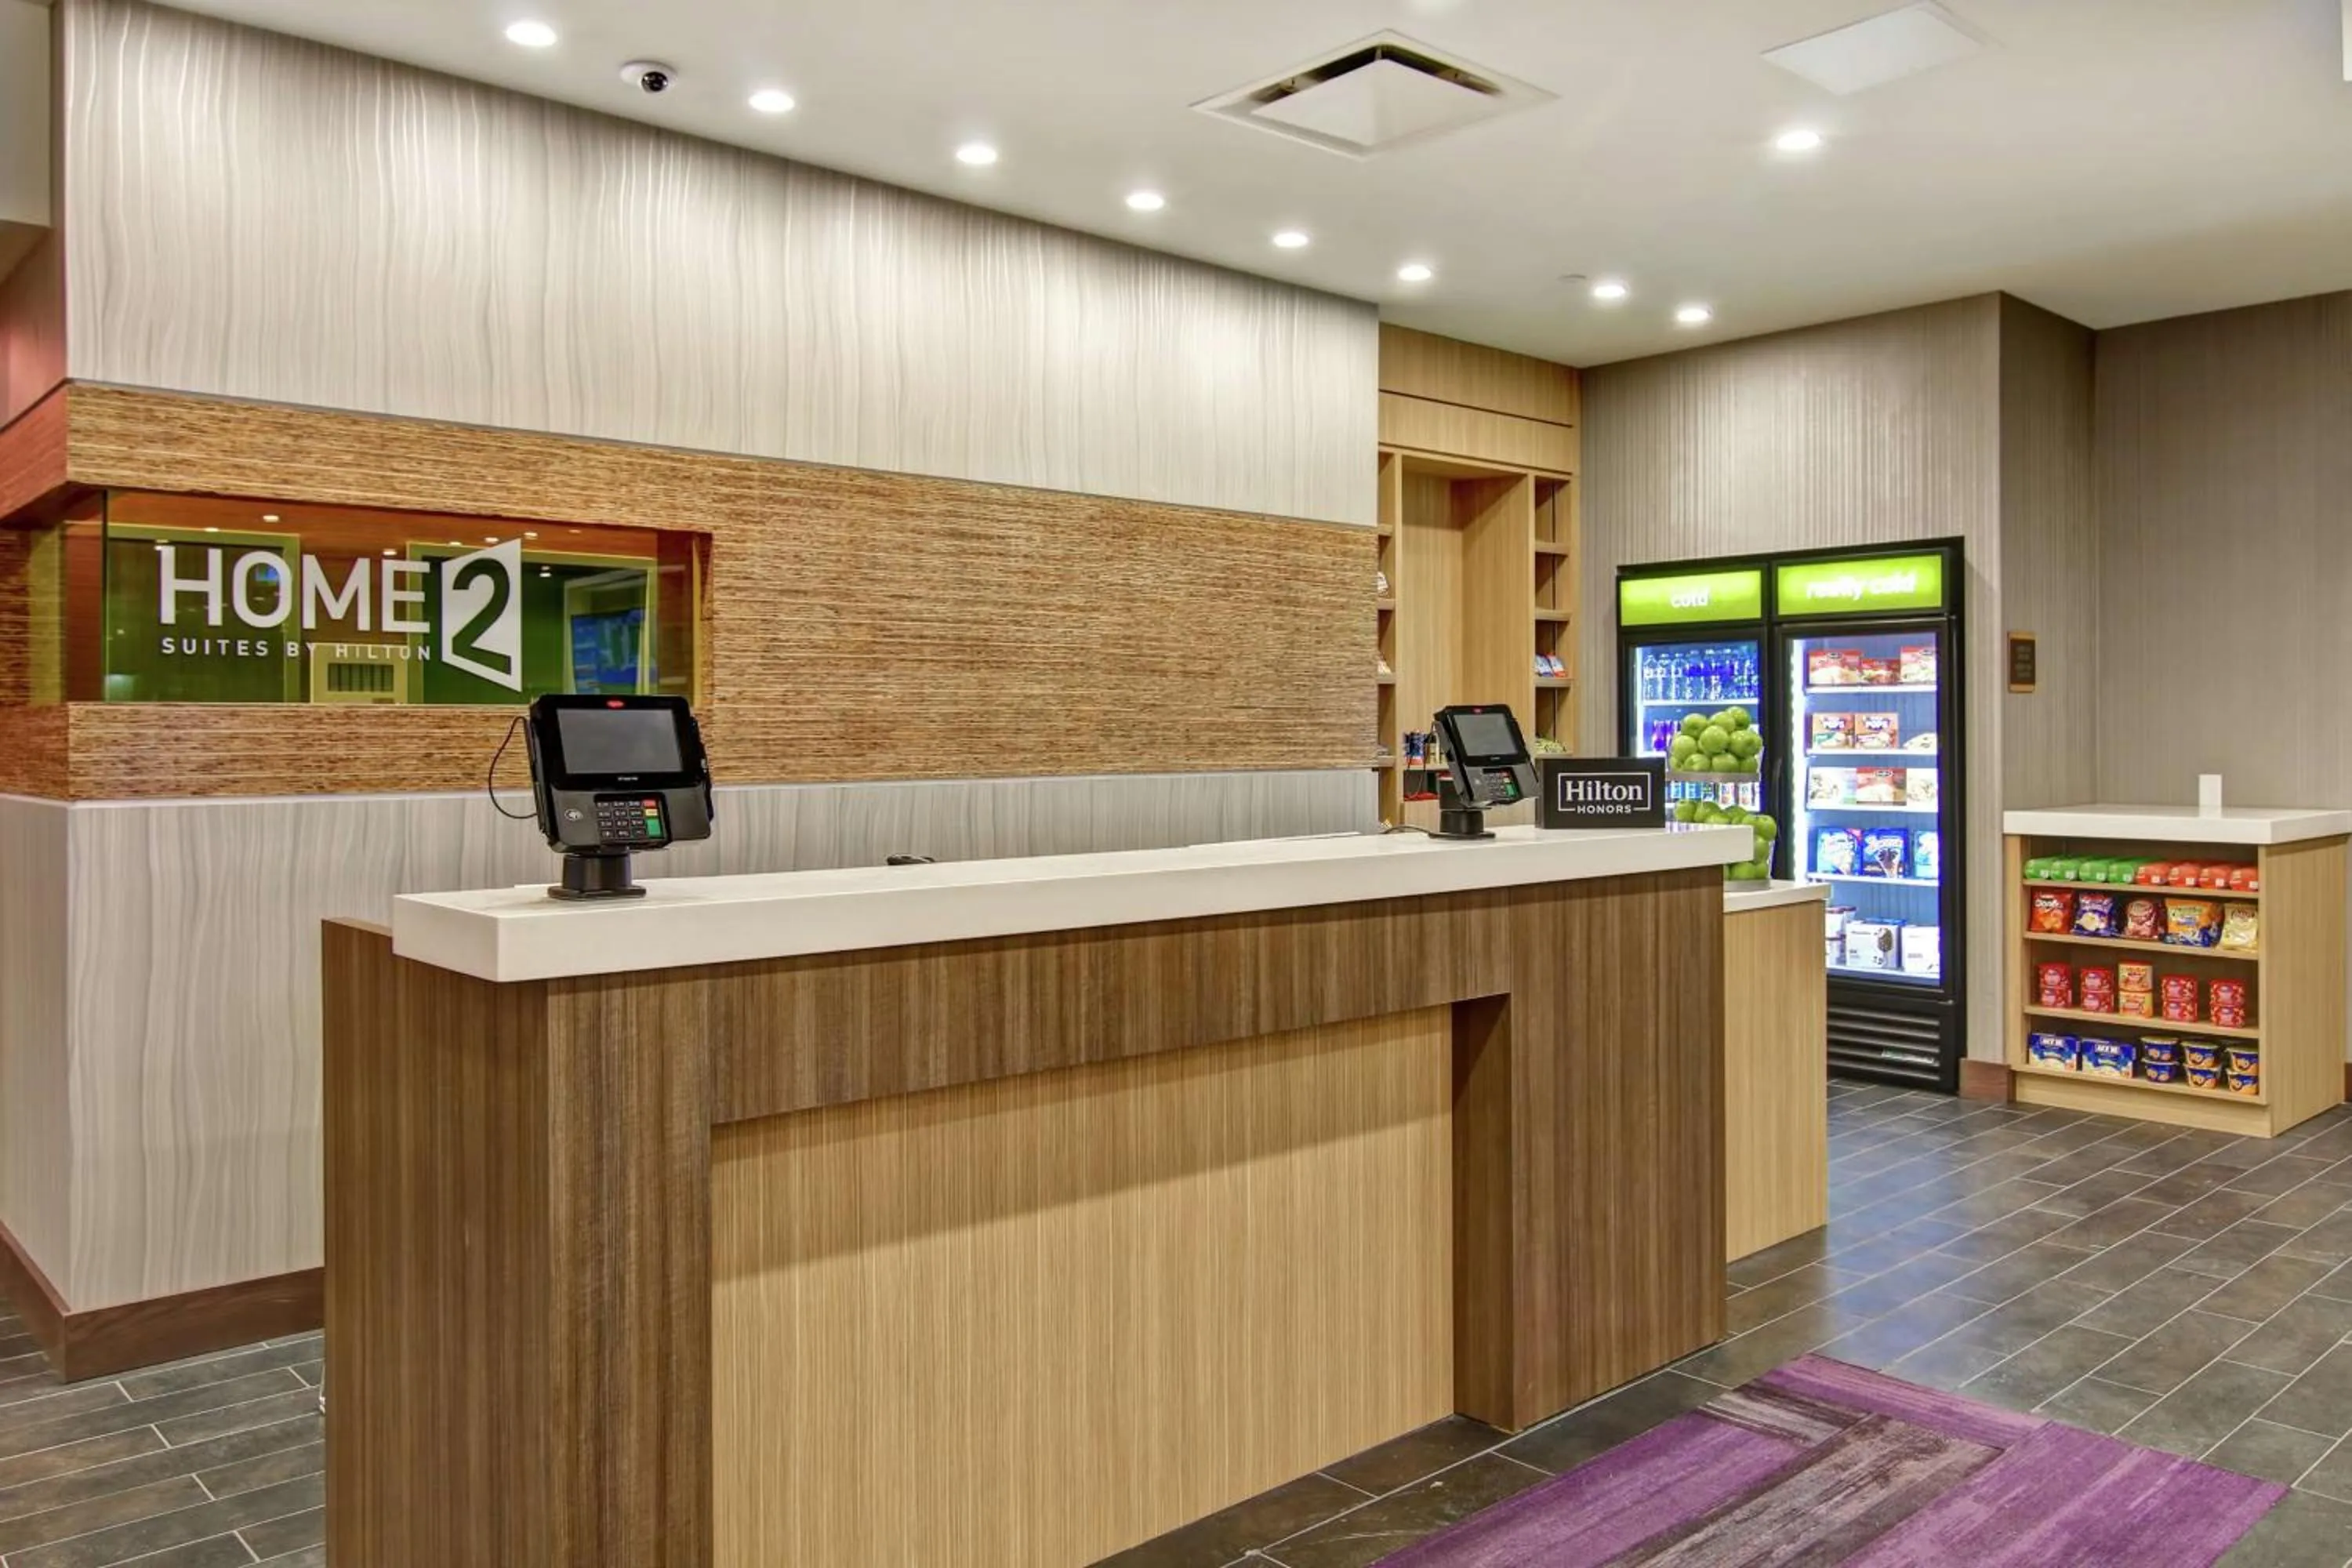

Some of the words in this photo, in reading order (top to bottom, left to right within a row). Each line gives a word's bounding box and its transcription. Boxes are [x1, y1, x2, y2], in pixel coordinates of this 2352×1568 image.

[160, 545, 430, 633] HOME
[1670, 586, 1710, 608] cold
[161, 637, 269, 655] SUITES
[286, 642, 316, 658] BY
[335, 644, 430, 660] HILTON
[1565, 780, 1643, 801] Hilton
[1577, 804, 1632, 814] HONORS
